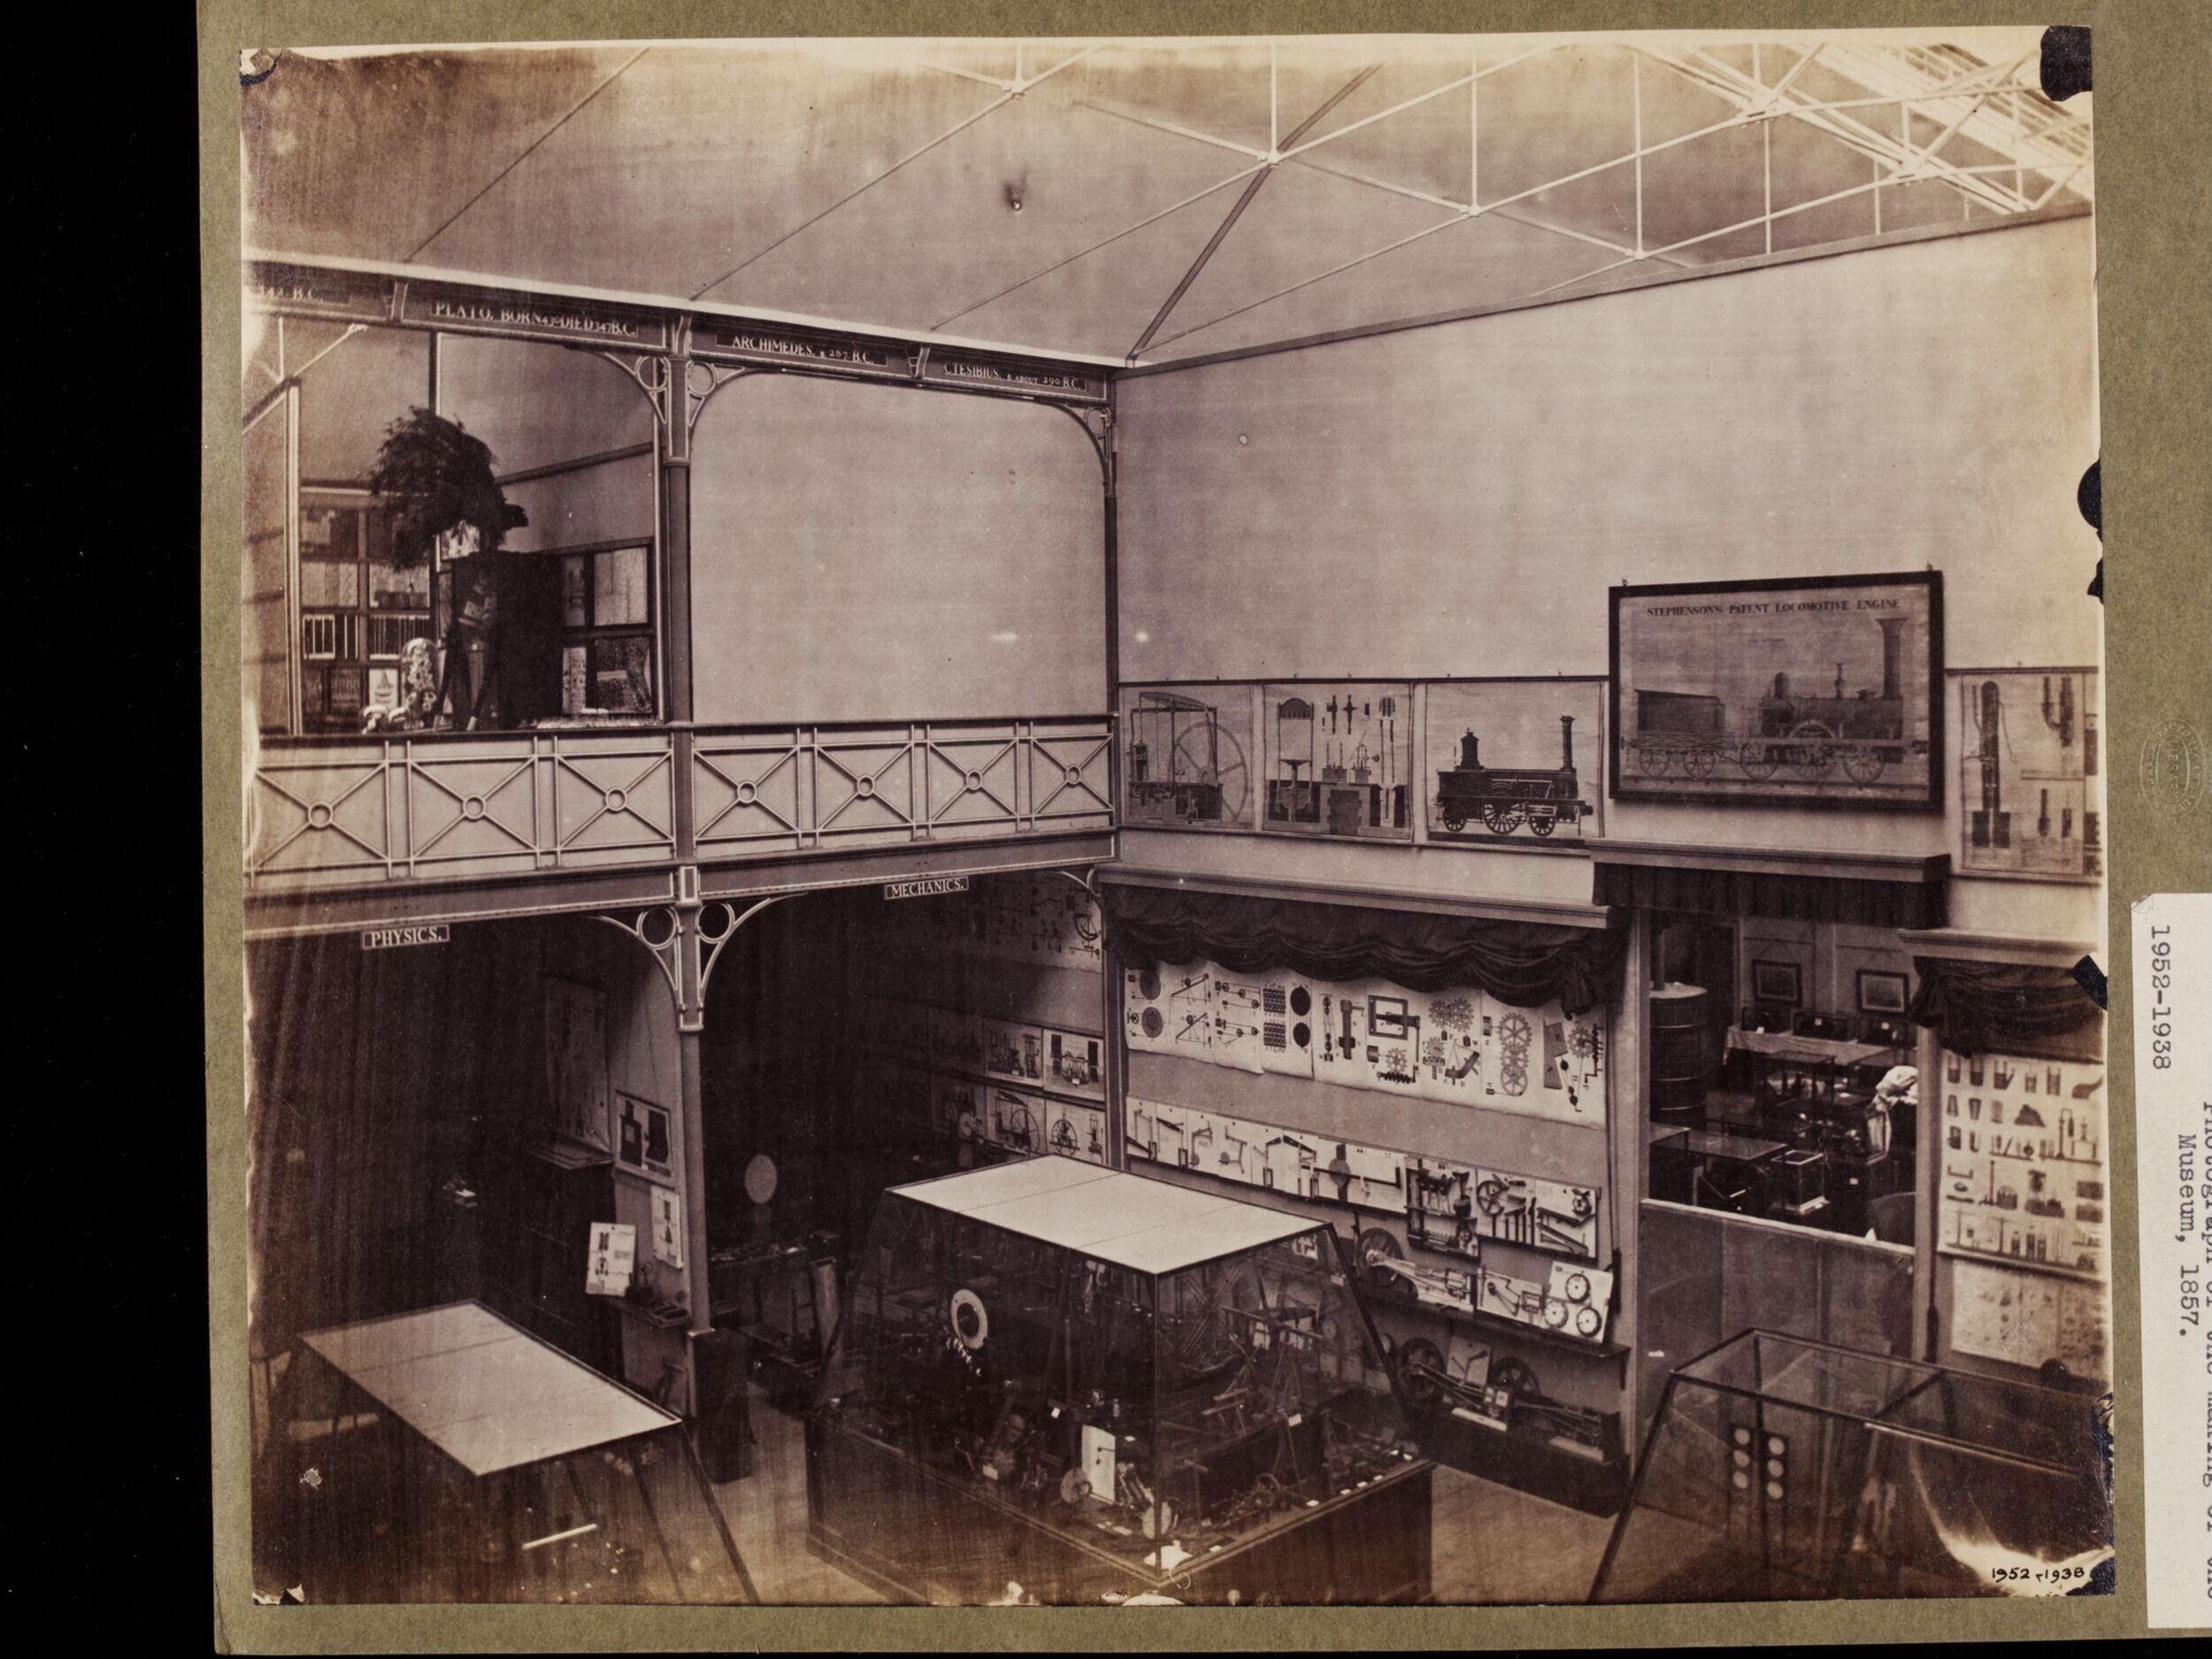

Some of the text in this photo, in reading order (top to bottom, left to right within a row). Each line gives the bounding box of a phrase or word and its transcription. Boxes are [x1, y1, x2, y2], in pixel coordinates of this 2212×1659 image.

[501, 309, 541, 326] BORN
[732, 335, 815, 357] ARCHIMEDES.
[1729, 603, 1769, 615] PATENT
[1775, 601, 1849, 614] LOCOMOTIVE
[1857, 599, 1901, 611] ENGINE
[891, 878, 964, 899] MECHANICS.
[371, 926, 443, 949] PHYSICS.
[2151, 926, 2171, 1070] 1952-1938
[2175, 1134, 2200, 1337] Museum, 1857.
